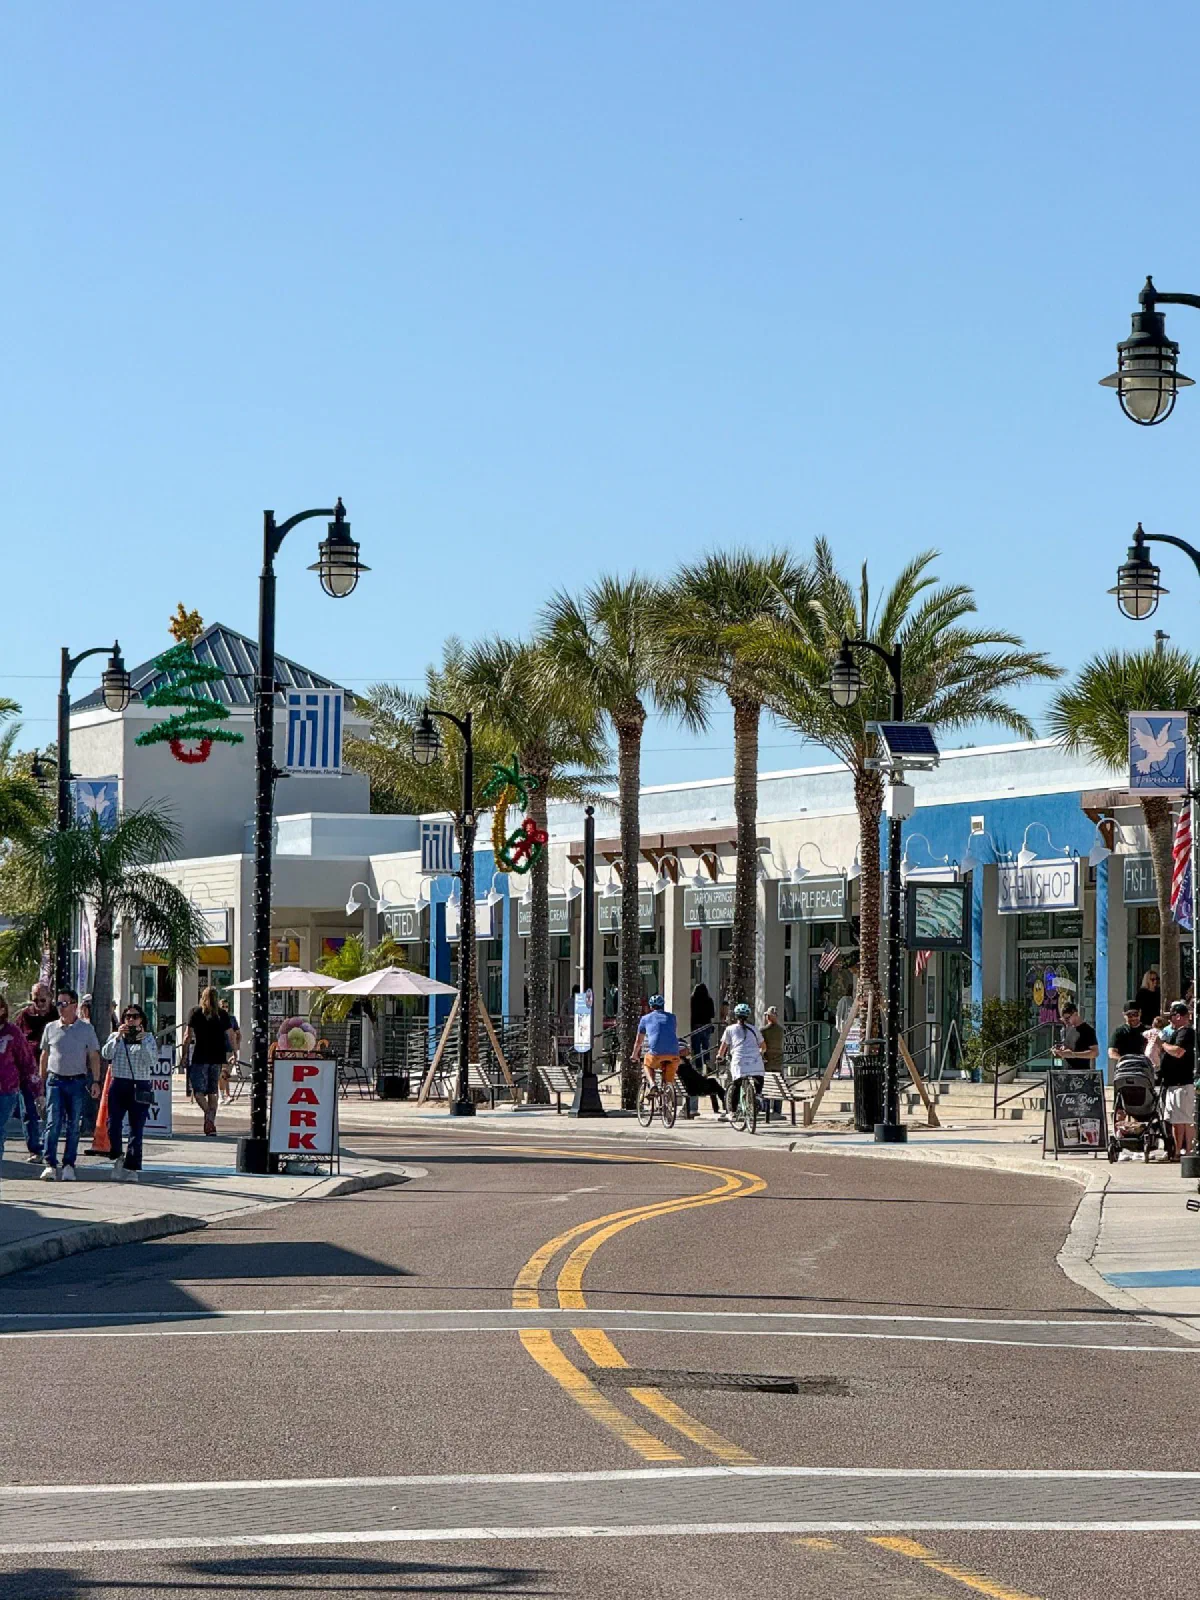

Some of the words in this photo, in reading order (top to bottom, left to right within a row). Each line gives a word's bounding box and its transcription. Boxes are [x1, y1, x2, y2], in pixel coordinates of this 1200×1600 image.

[1136, 776, 1180, 784] EPIPHANY
[1002, 872, 1036, 901] SHELL
[1036, 871, 1071, 898] SHOP
[1125, 868, 1147, 892] FISH
[713, 891, 732, 903] SPRINGS
[816, 889, 843, 908] PEACE
[712, 907, 735, 920] COMPAN
[384, 912, 414, 936] GIFTED
[287, 1065, 320, 1150] PARK
[1056, 1093, 1076, 1107] Tea
[1077, 1093, 1099, 1105] Bar
